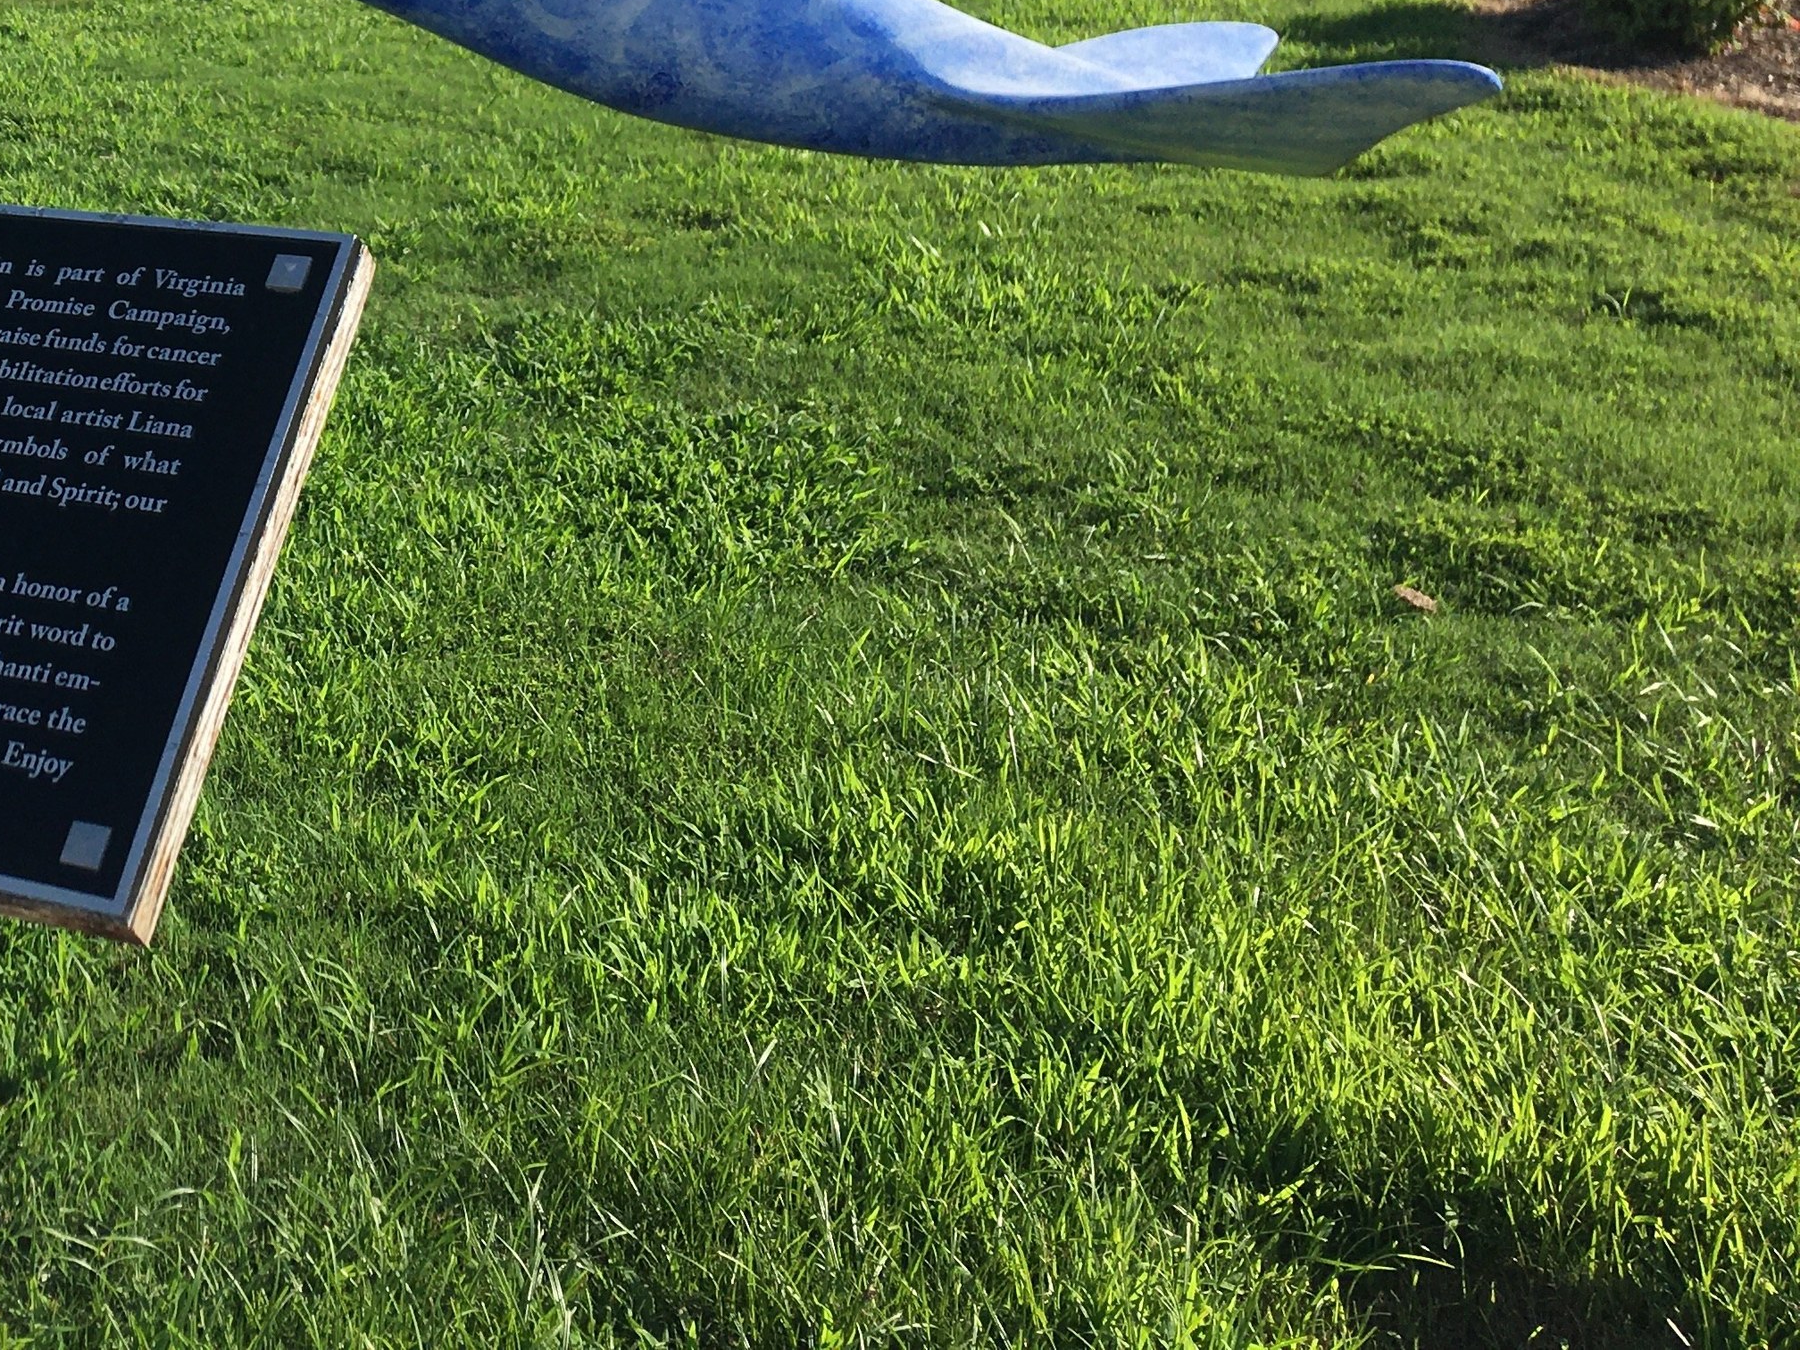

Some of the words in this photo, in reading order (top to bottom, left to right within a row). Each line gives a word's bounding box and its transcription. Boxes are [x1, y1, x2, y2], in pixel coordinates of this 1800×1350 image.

[24, 258, 46, 277] is
[53, 266, 106, 286] part
[116, 266, 147, 286] of
[154, 268, 246, 298] Virginia
[4, 288, 96, 317] Promise
[107, 299, 231, 335] Campaign,
[41, 327, 107, 354] funds
[110, 335, 146, 358] for
[146, 345, 222, 366] cancer
[99, 371, 172, 397] efforts
[172, 378, 209, 402] for
[0, 394, 58, 421] local
[59, 408, 124, 430] artist
[125, 410, 193, 439] Liana
[83, 444, 115, 466] of
[123, 449, 182, 475] what
[0, 474, 47, 496] and
[46, 476, 122, 511] Spirit;
[124, 494, 168, 513] our
[10, 571, 82, 604] honor
[85, 585, 118, 608] of
[114, 596, 130, 612] a
[30, 623, 90, 647] word
[90, 631, 116, 651] to
[54, 670, 101, 691] em-
[46, 706, 86, 734] the
[0, 739, 74, 783] Enjoy
